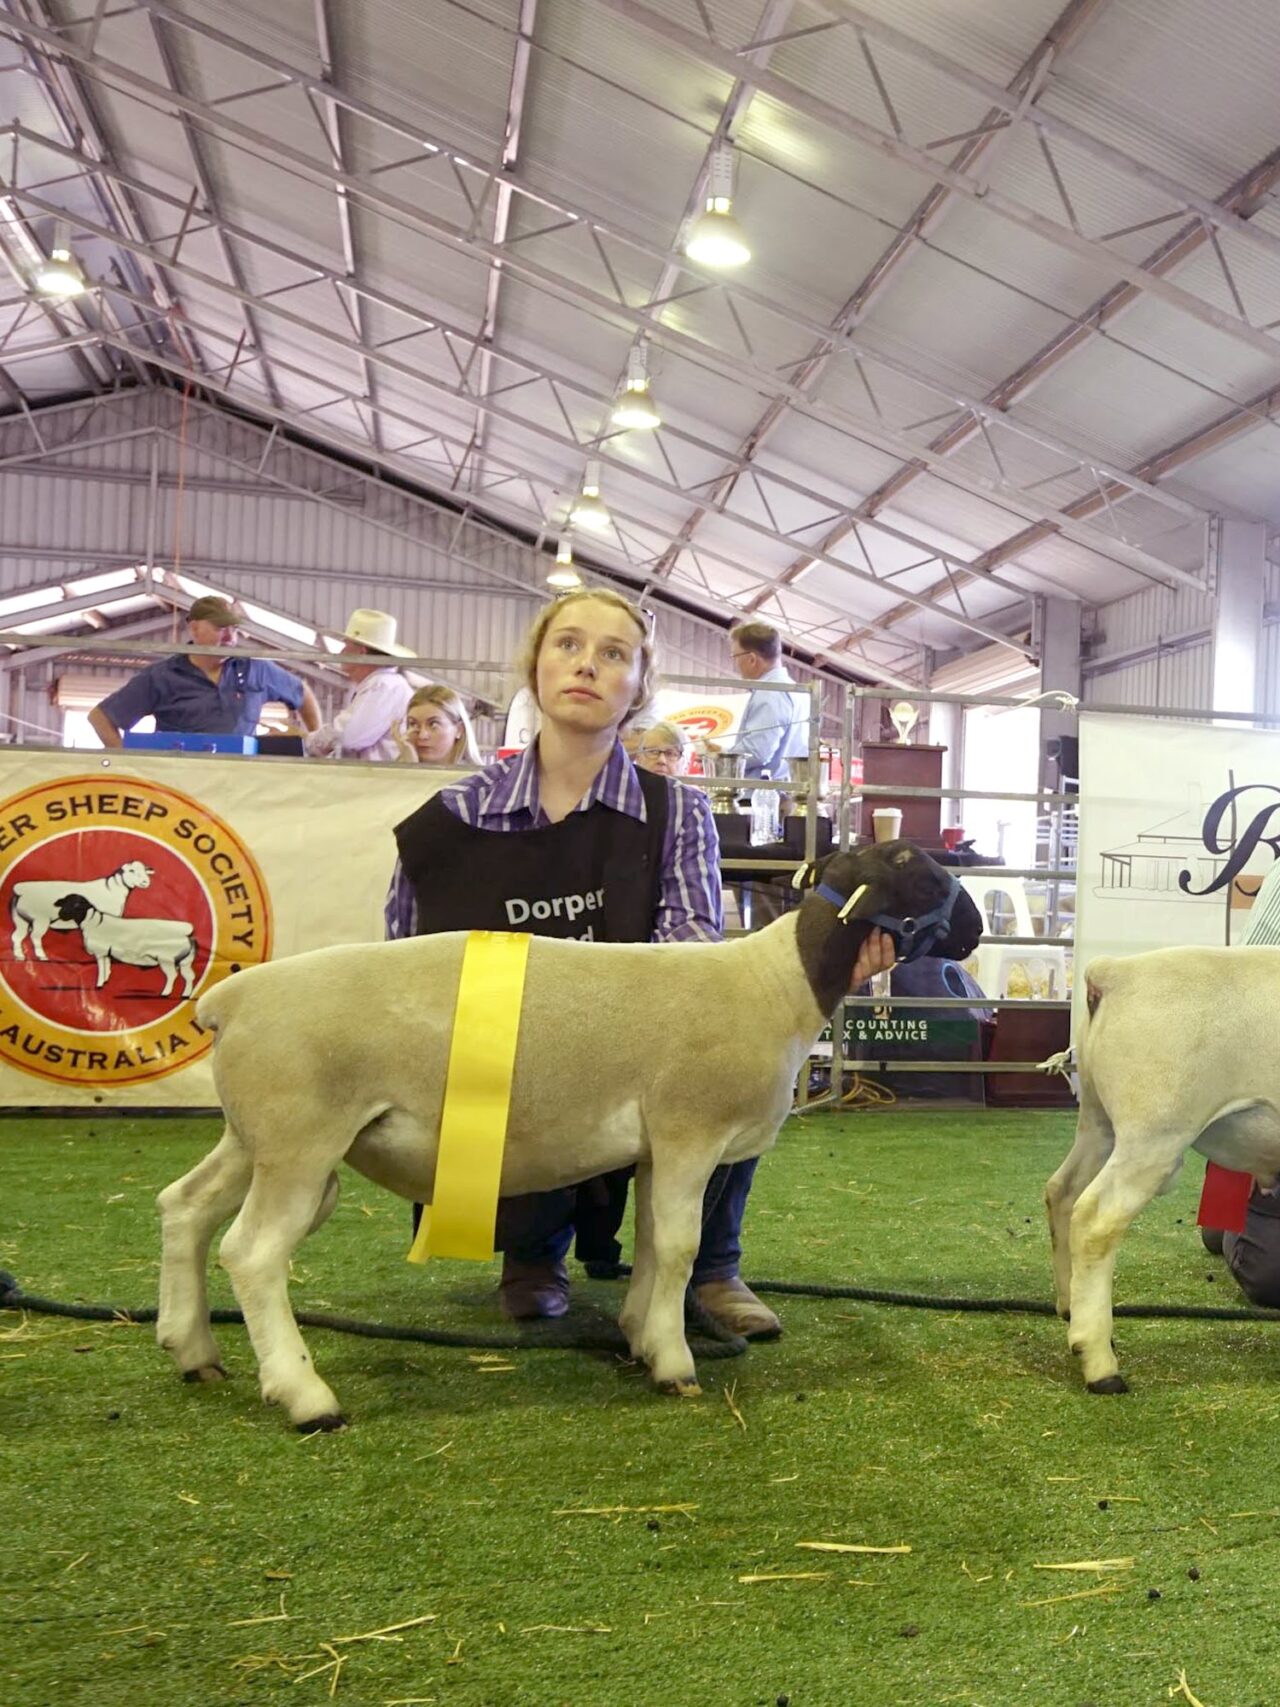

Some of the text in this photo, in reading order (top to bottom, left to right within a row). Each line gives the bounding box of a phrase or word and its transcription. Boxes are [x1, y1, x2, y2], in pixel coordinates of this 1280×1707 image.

[46, 794, 169, 822] SHEEP
[173, 819, 255, 950] SOCIETY
[505, 888, 605, 925] Dorper
[824, 1030, 928, 1040] TX & ADVICE
[825, 1019, 928, 1031] ACOUNTING
[0, 1024, 190, 1070] AUSTRALIA
